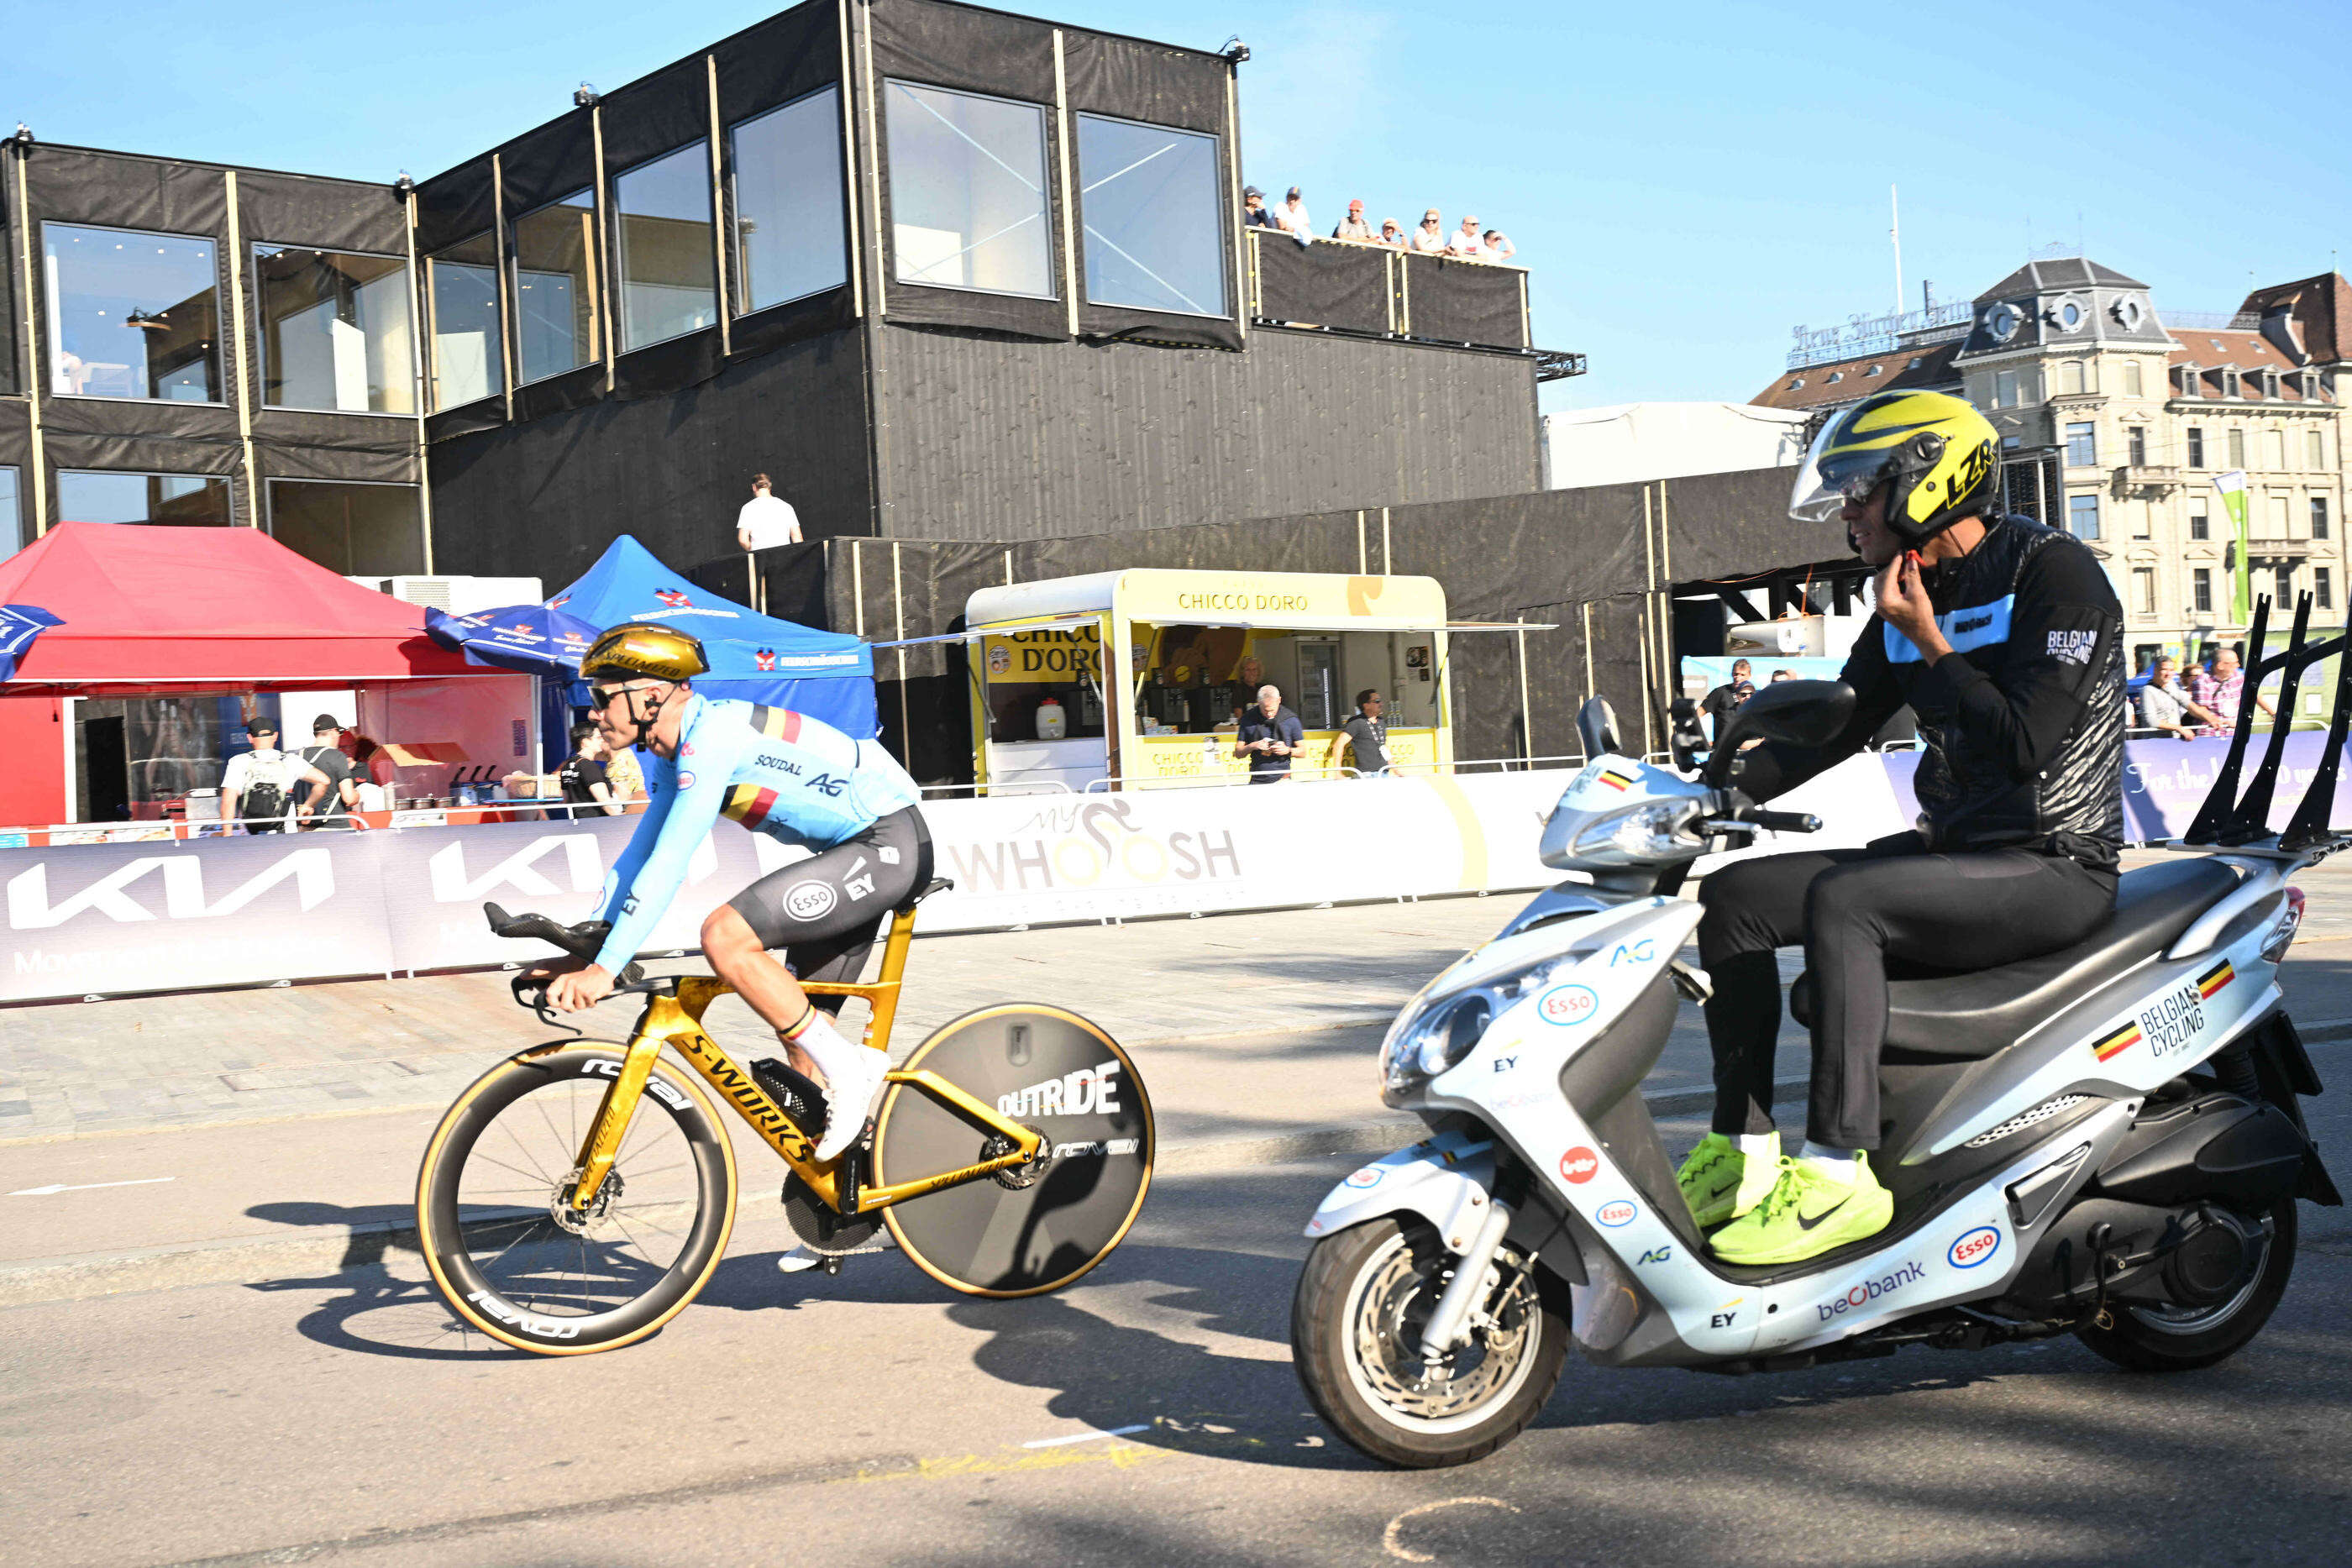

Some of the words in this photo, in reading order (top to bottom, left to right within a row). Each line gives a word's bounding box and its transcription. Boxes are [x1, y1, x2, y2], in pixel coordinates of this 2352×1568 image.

[1179, 594, 1249, 610] CHICCO
[1256, 595, 1309, 611] DORO
[2046, 630, 2097, 648] BELGIAN
[605, 652, 681, 677] SPECIALIZED
[754, 754, 802, 776] SOUDAL
[2176, 758, 2208, 789] the
[948, 830, 1242, 893] WHOOSH
[8, 847, 335, 930] KIA
[844, 873, 876, 902] EY
[622, 891, 641, 916] EY
[2140, 983, 2198, 1035] BELGIAN
[2150, 1007, 2204, 1057] CYCLING
[1494, 1055, 1519, 1073] EY
[681, 1035, 811, 1163] S-WORKS
[997, 1059, 1121, 1118] OUTRIDE
[1710, 1312, 1737, 1329] EY
